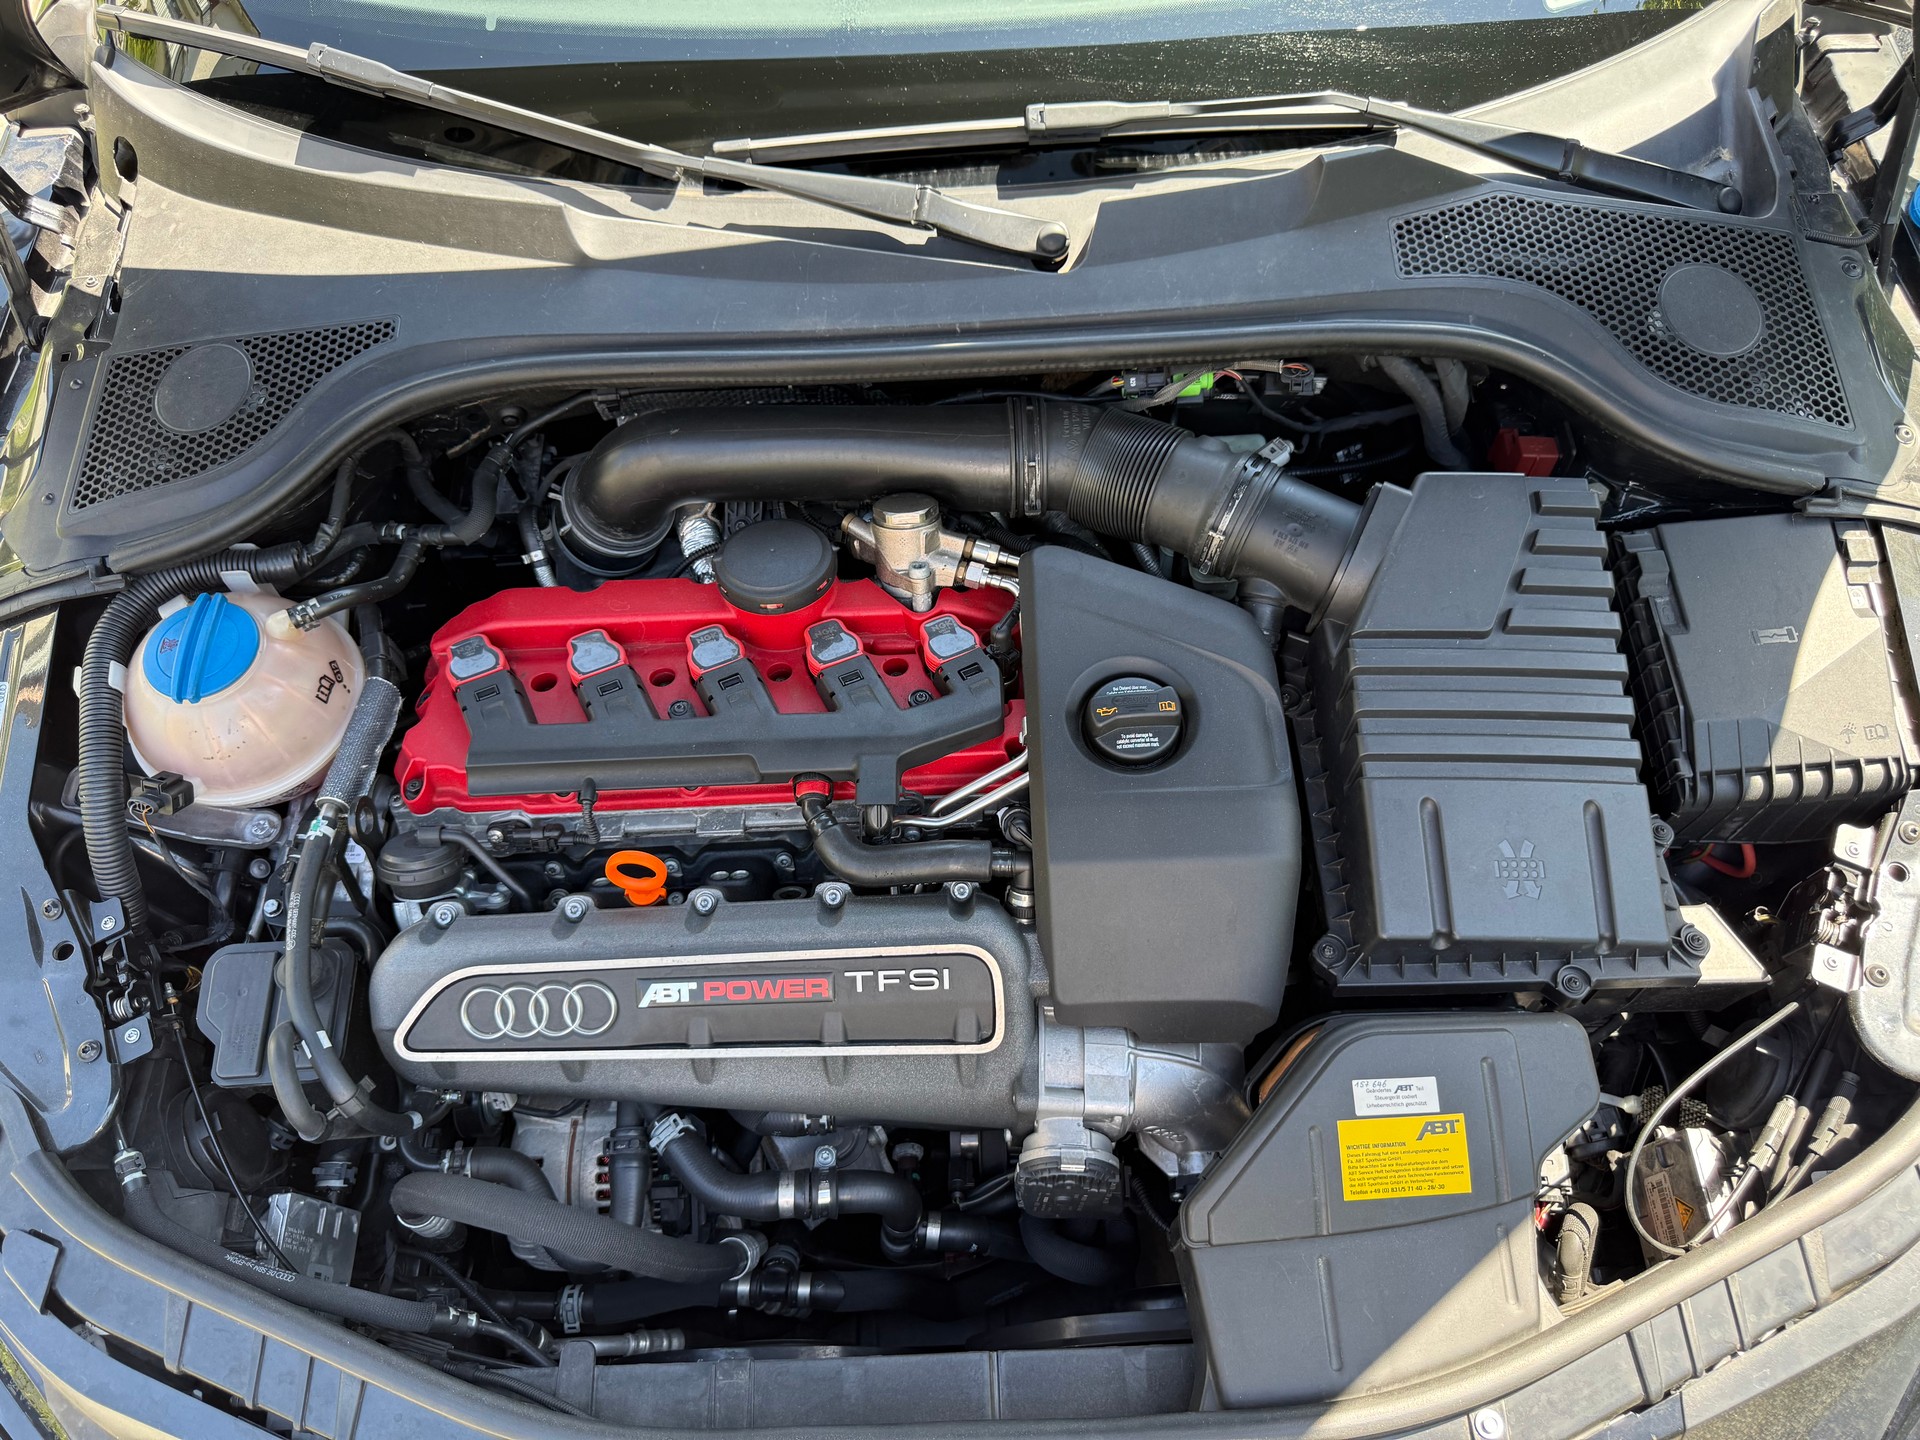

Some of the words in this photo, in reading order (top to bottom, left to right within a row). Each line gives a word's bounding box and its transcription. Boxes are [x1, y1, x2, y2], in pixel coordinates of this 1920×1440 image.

[814, 626, 838, 638] NGK
[931, 619, 953, 632] NGK
[638, 980, 699, 1008] ABT
[704, 977, 829, 1000] POWER
[844, 968, 952, 993] TFSI
[1394, 1084, 1414, 1094] ABT
[1416, 1120, 1458, 1141] ABT
